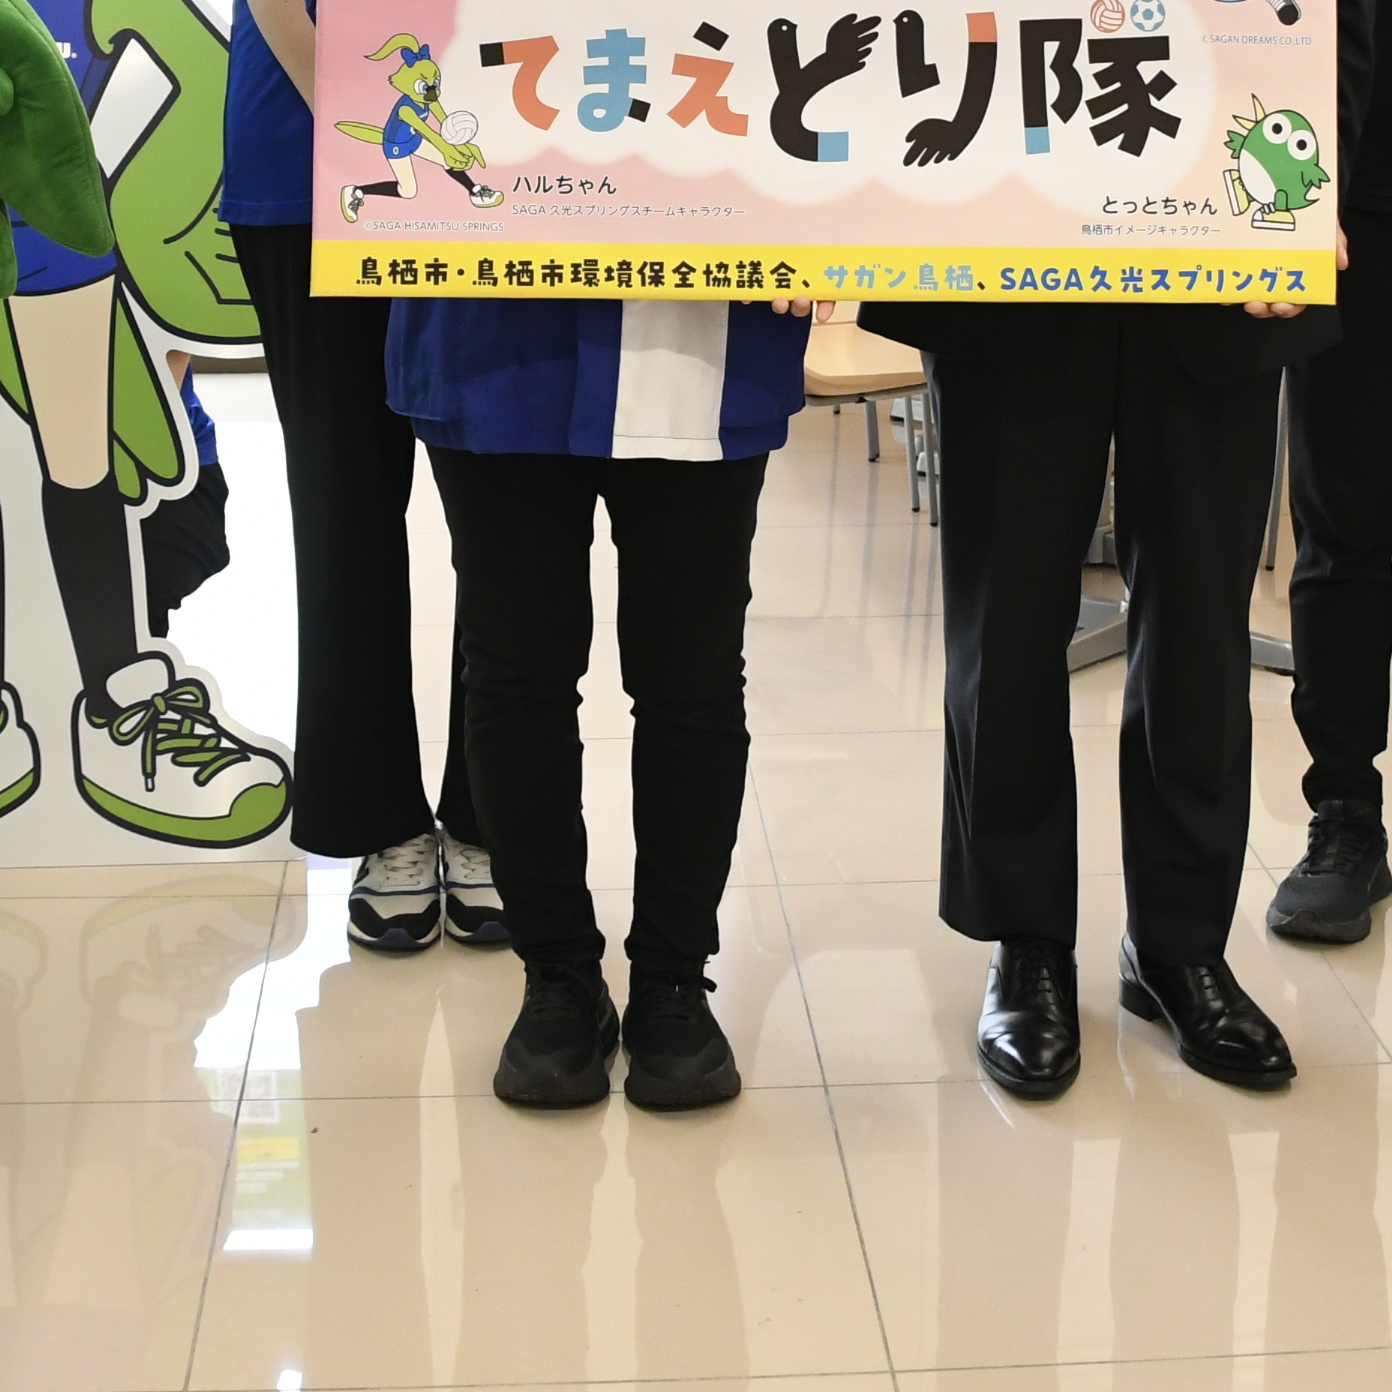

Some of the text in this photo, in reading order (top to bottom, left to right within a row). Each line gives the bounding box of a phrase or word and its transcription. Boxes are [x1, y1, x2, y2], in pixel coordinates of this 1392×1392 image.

[1210, 35, 1240, 44] SAGAN
[1242, 35, 1277, 45] DREAMS
[480, 9, 1182, 168] てまえどり隊
[512, 175, 617, 195] ハルちゃん
[512, 204, 745, 219] SAGA 久光スプリングスチームキャラクター
[1102, 196, 1218, 215] とっとちゃん
[404, 221, 458, 231] HISAMITSU
[462, 222, 504, 232] SPRINGS
[1080, 224, 1221, 237] 鳥栖市イメージキャラクター
